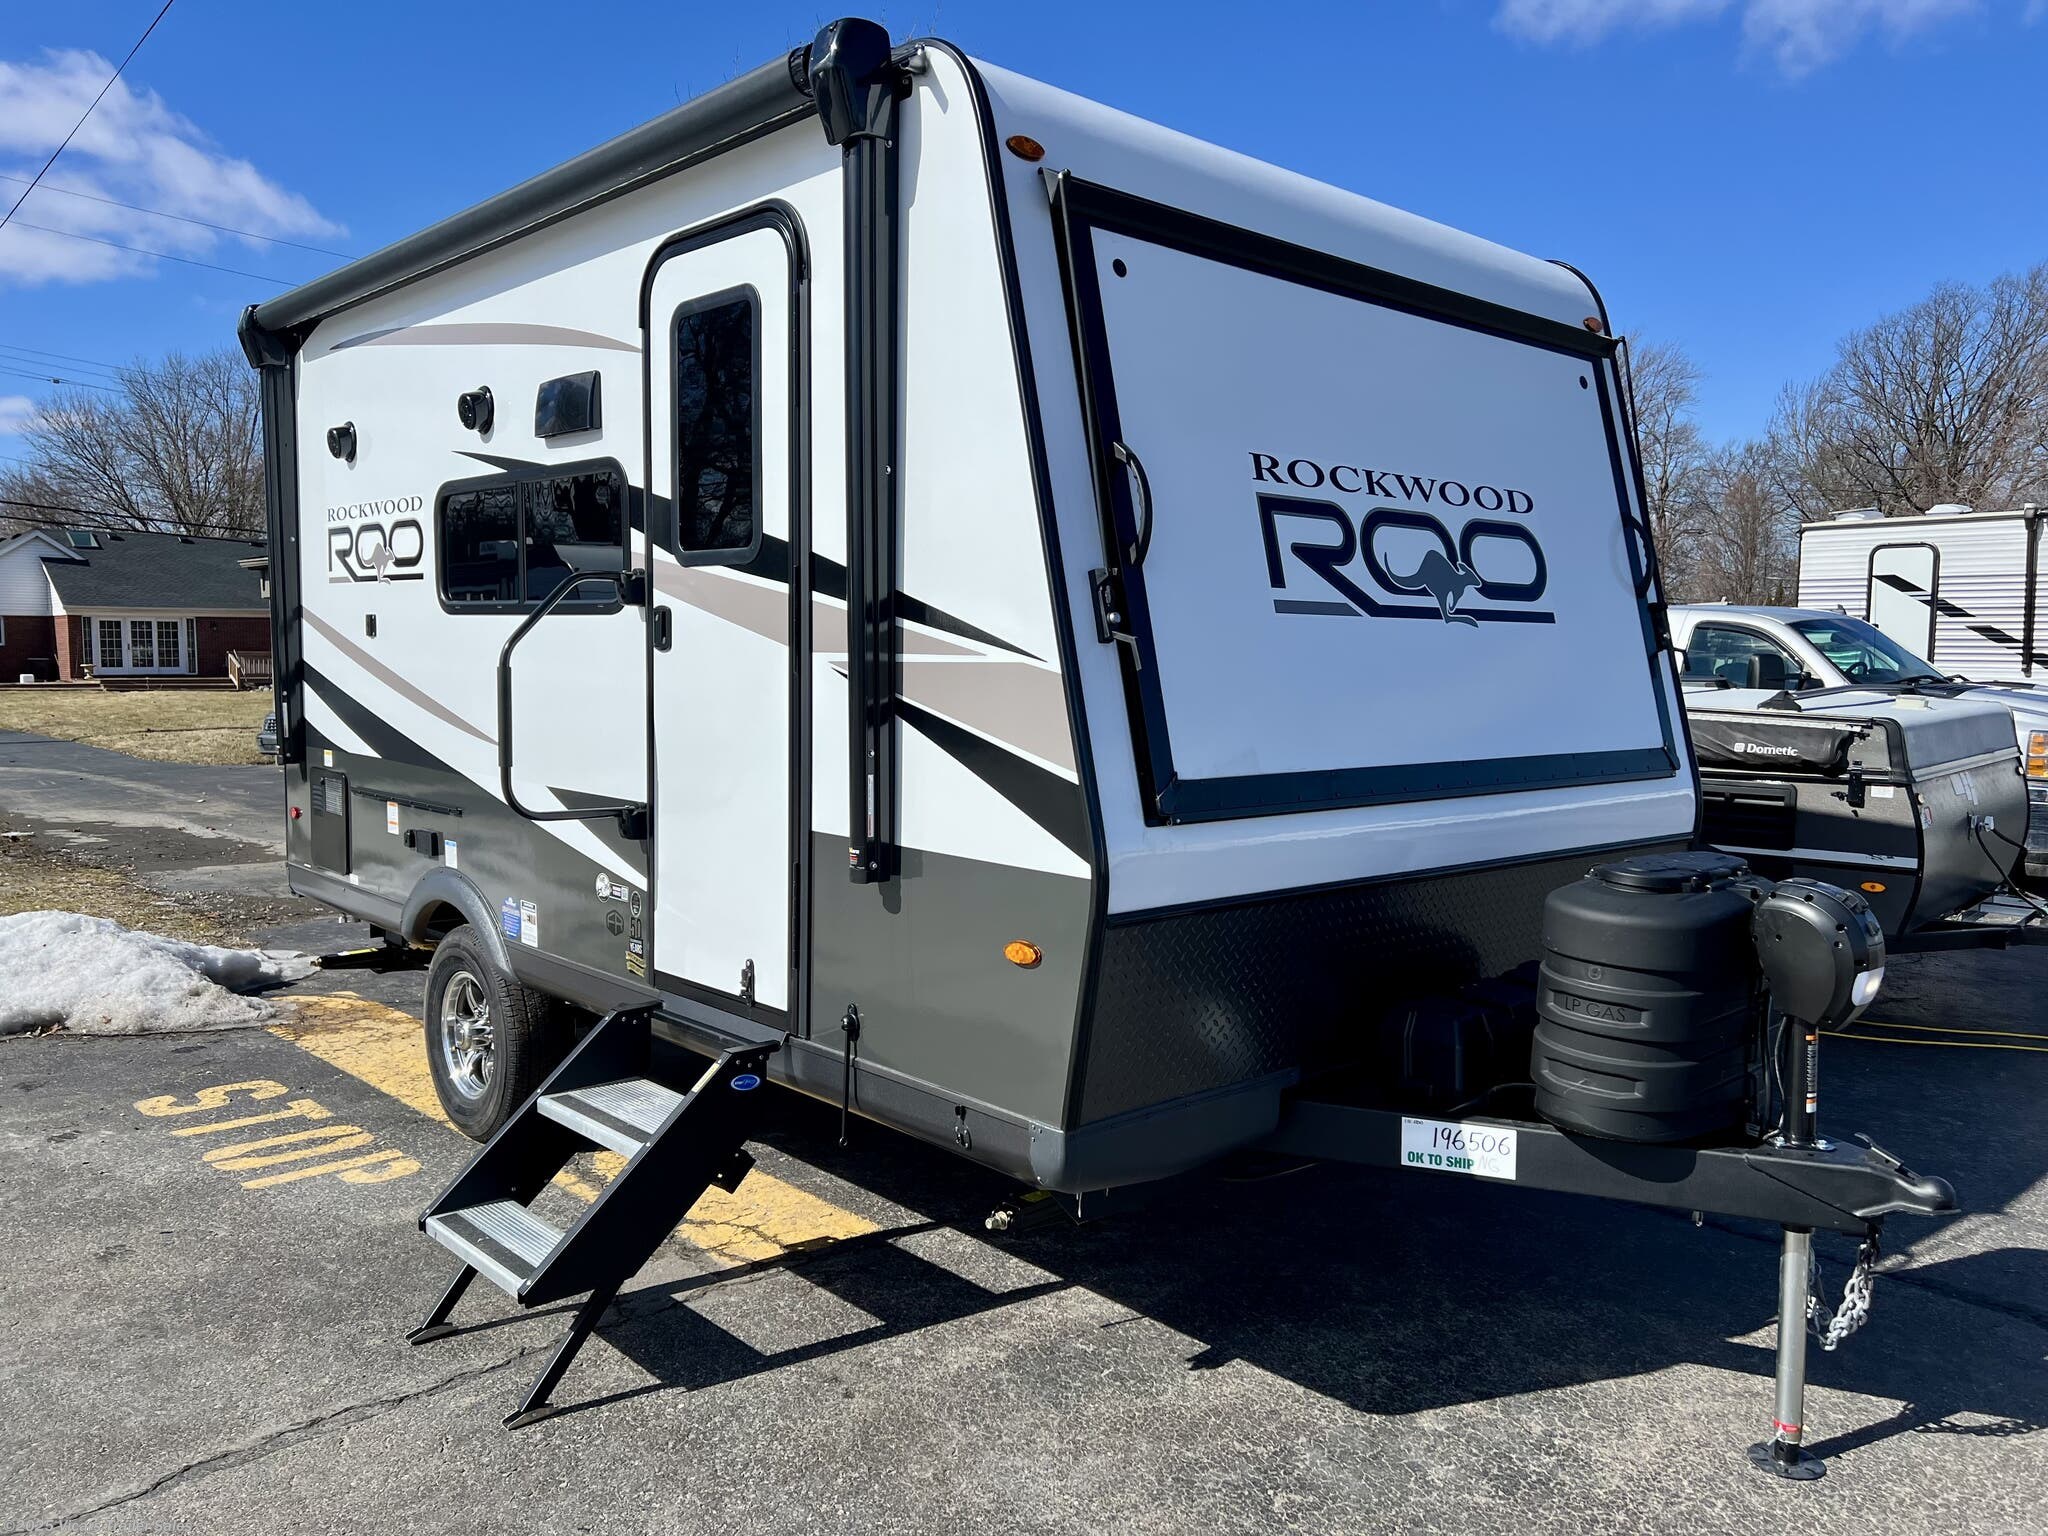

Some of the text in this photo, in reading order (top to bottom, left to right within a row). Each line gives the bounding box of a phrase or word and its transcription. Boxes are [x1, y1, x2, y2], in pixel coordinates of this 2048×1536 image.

[1248, 451, 1534, 514] ROCKWOOD
[327, 496, 423, 522] ROCKWOOD
[327, 517, 424, 583] ROO
[1256, 491, 1556, 625] ROO
[1746, 743, 1799, 757] Dometic
[1565, 996, 1626, 1022] LP GAS
[132, 1079, 424, 1191] STOP
[1433, 1127, 1511, 1155] 196506
[1407, 1151, 1475, 1170] OK TO SHIP
